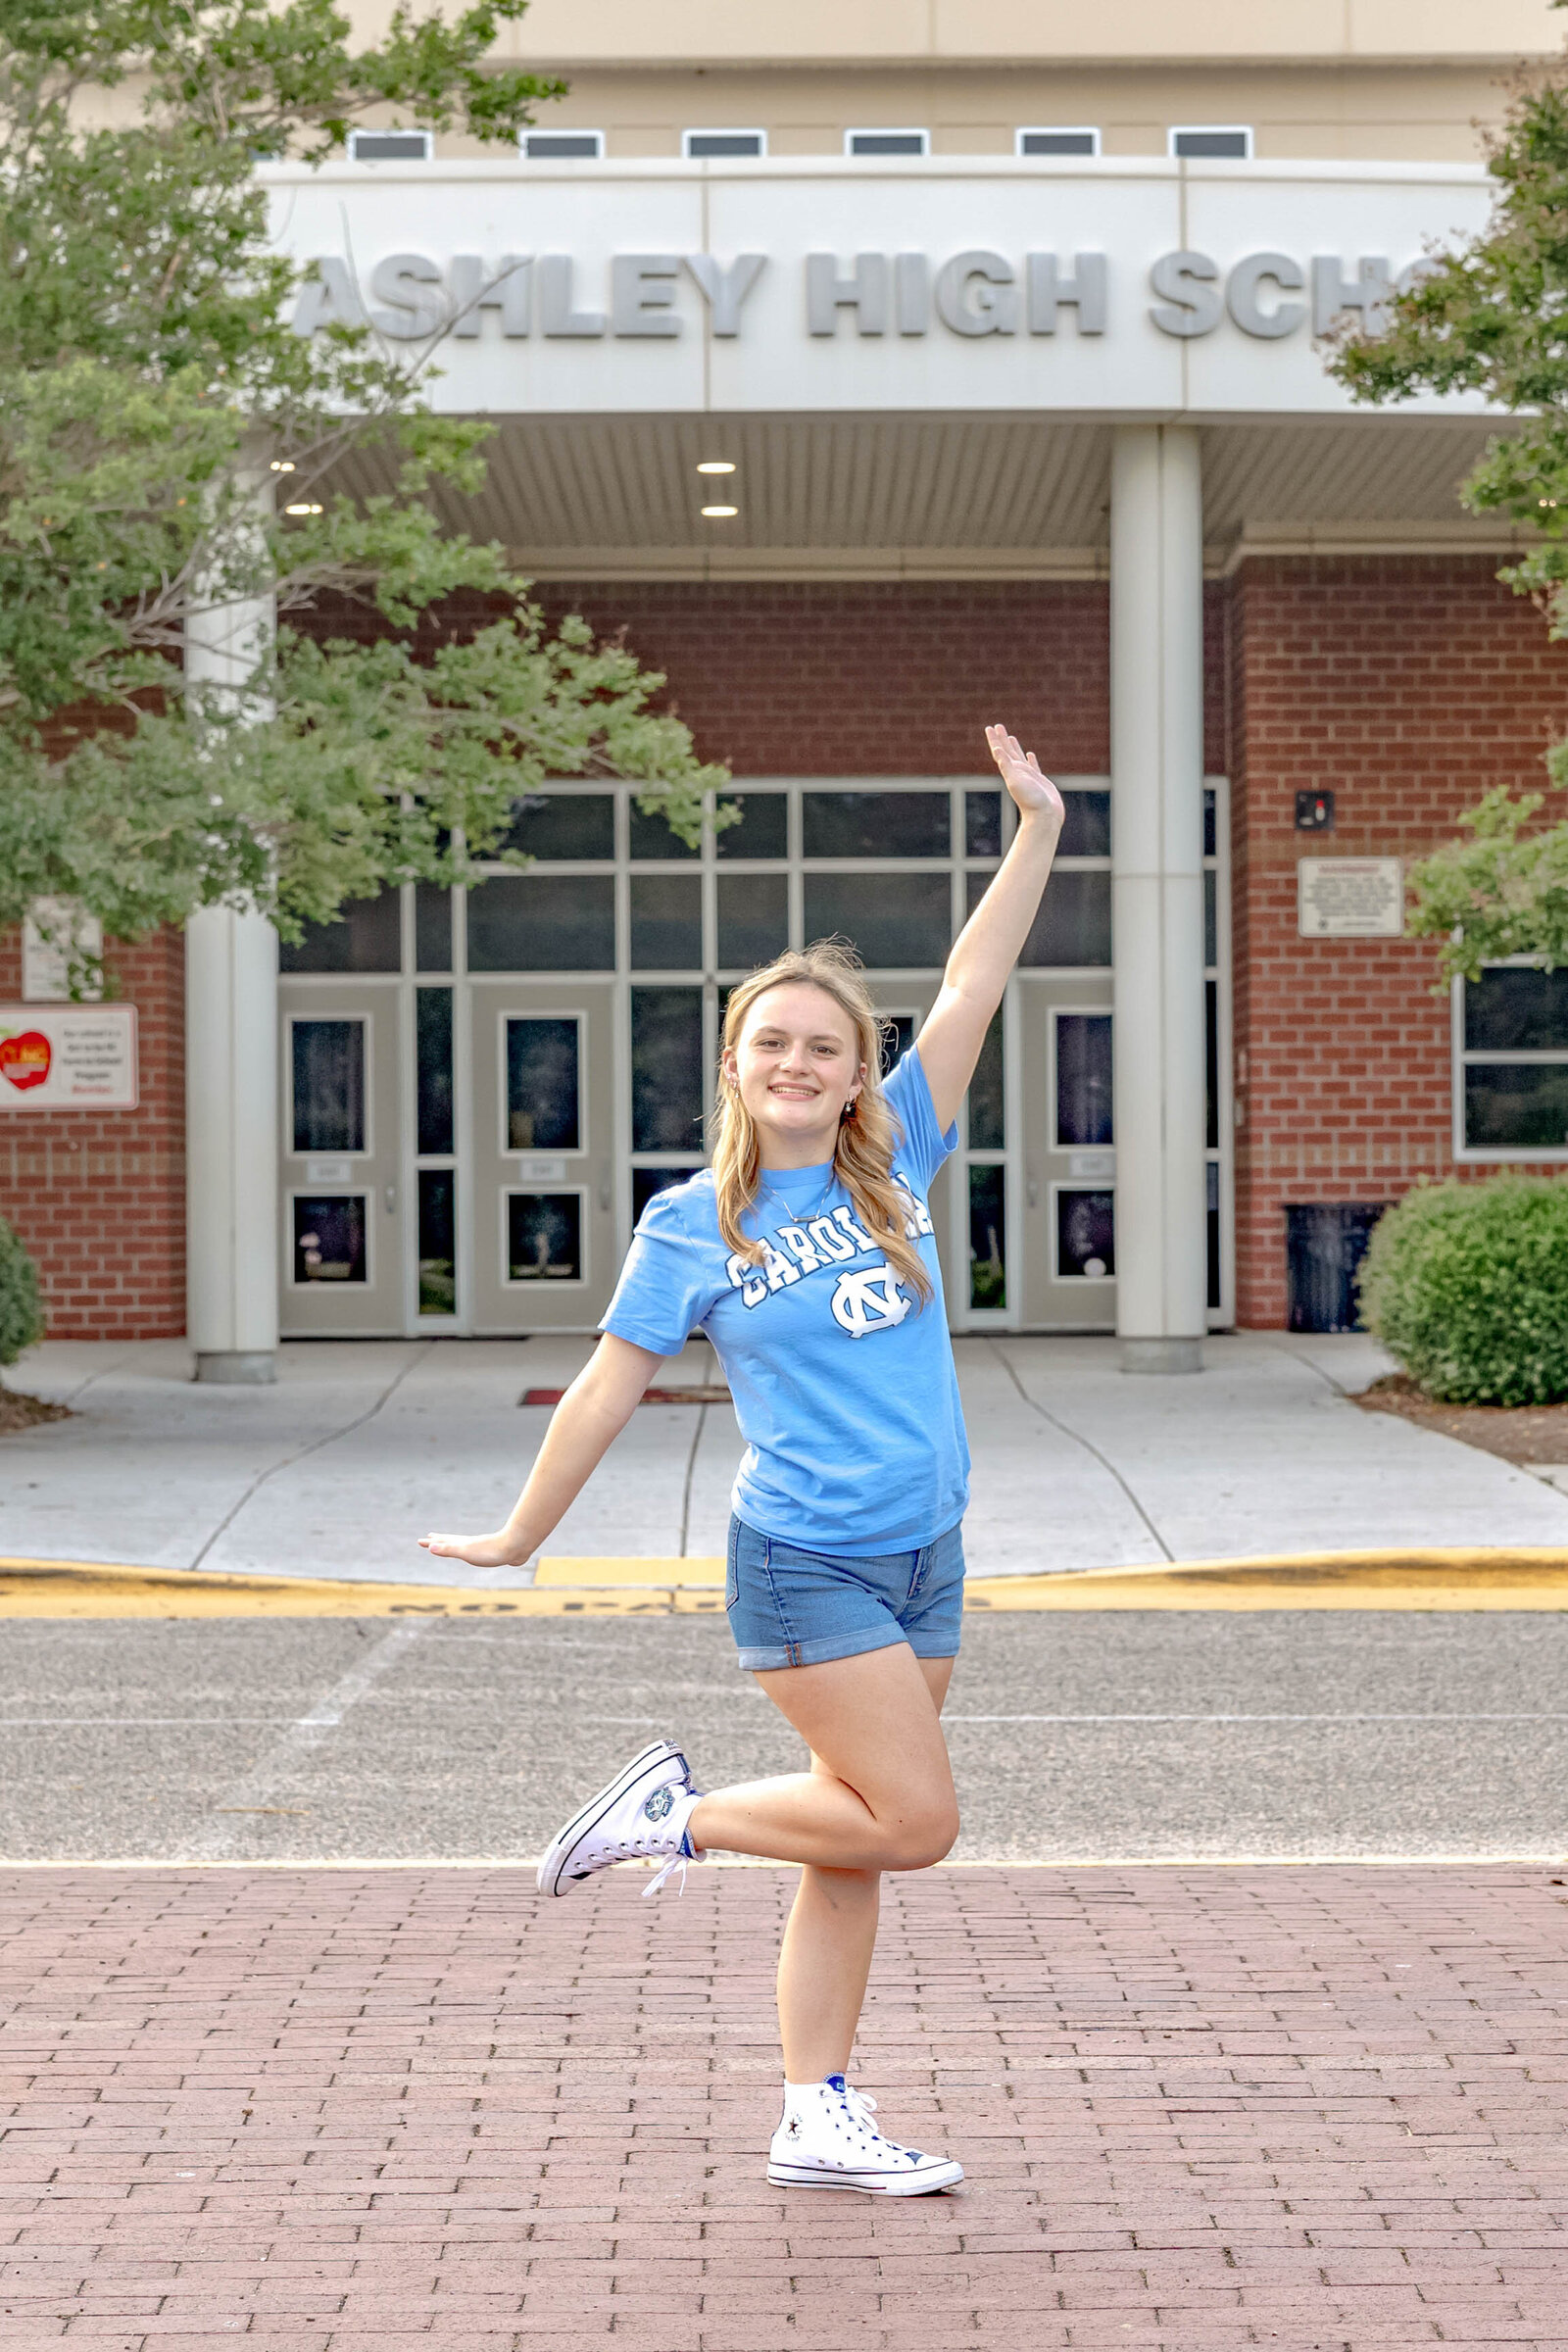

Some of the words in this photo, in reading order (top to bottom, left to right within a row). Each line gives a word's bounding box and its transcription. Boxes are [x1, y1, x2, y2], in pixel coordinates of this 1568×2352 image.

[293, 254, 766, 340] ASHLEY
[806, 250, 1107, 338] HIGH
[725, 1172, 935, 1310] CAROLA
